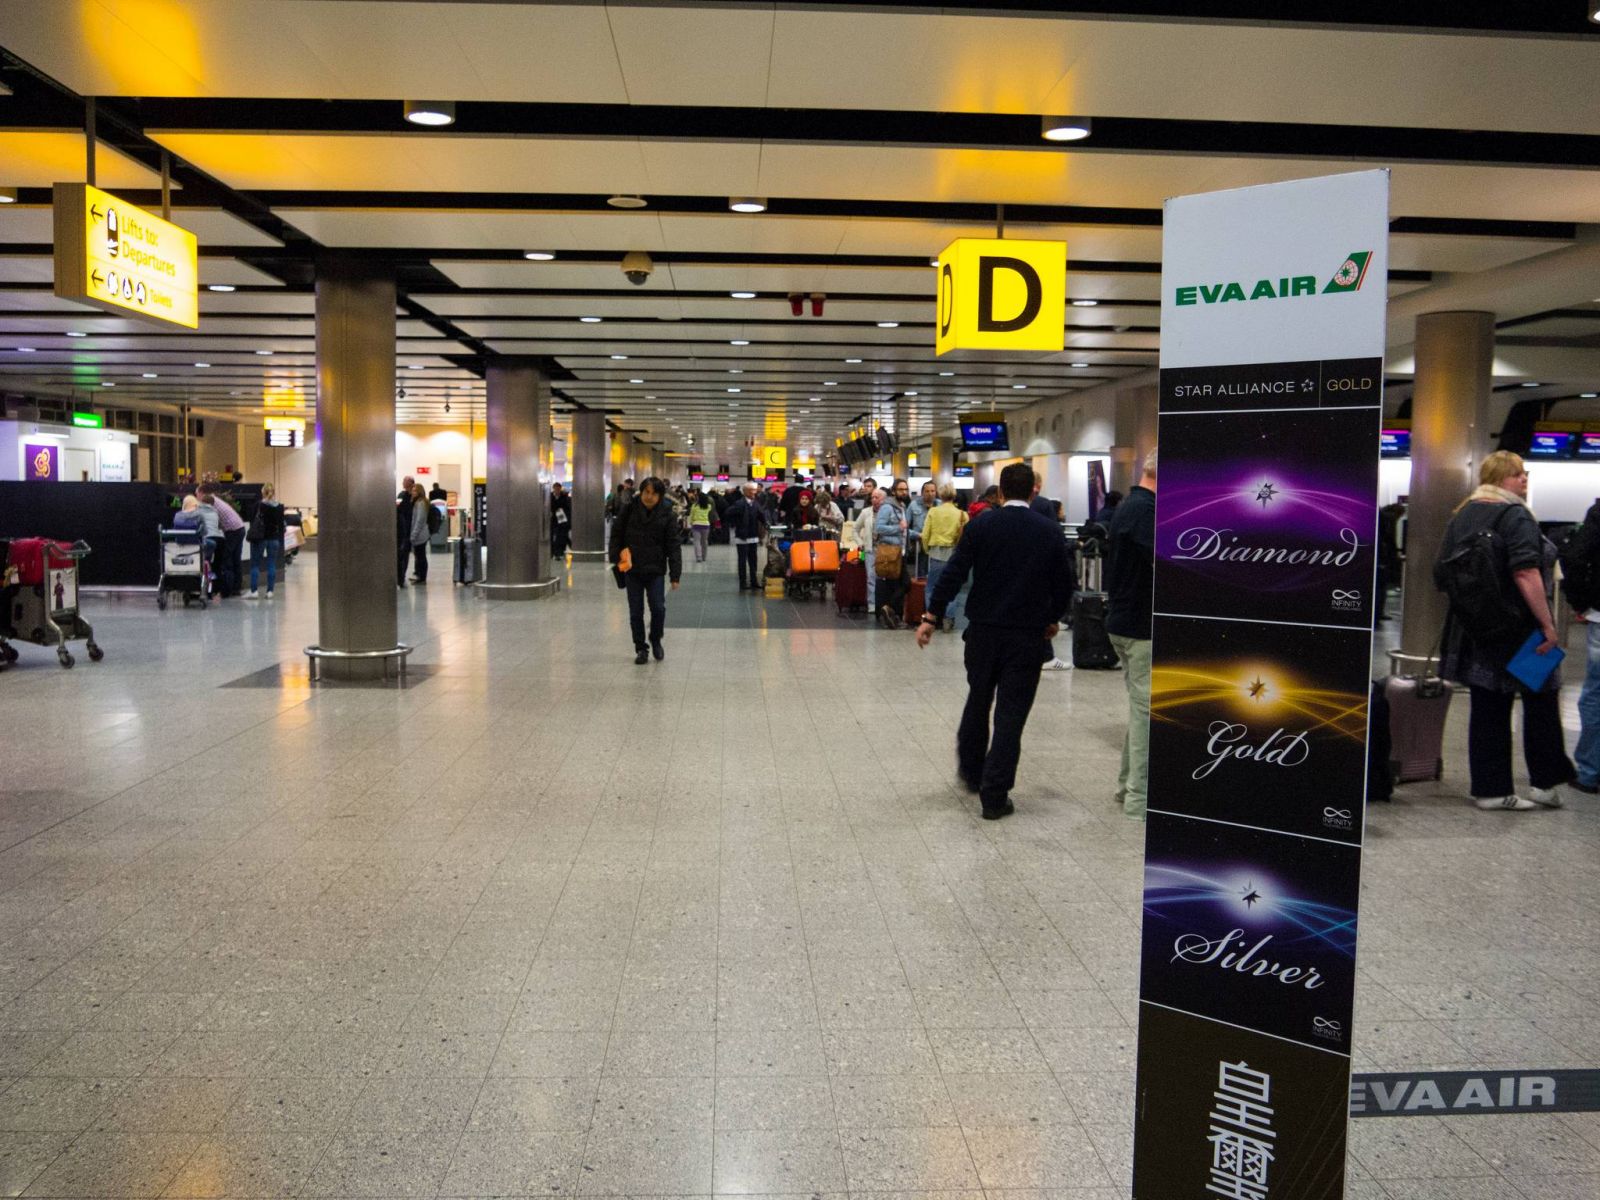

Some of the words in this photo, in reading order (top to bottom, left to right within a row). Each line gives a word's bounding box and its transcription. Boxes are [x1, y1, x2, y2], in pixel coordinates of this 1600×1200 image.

[121, 216, 143, 240] Lifts
[122, 241, 176, 277] Departures
[941, 263, 953, 338] D
[978, 256, 1042, 332] D
[1174, 385, 1212, 397] STAR
[1219, 381, 1296, 395] ALLIANCE
[1326, 378, 1372, 391] GOLD
[770, 450, 781, 465] C
[1171, 527, 1369, 566] Diamond
[1331, 600, 1362, 608] INFINITY
[1192, 720, 1309, 780] Gold
[1322, 816, 1352, 827] INFINITY
[1170, 928, 1325, 989] Silver
